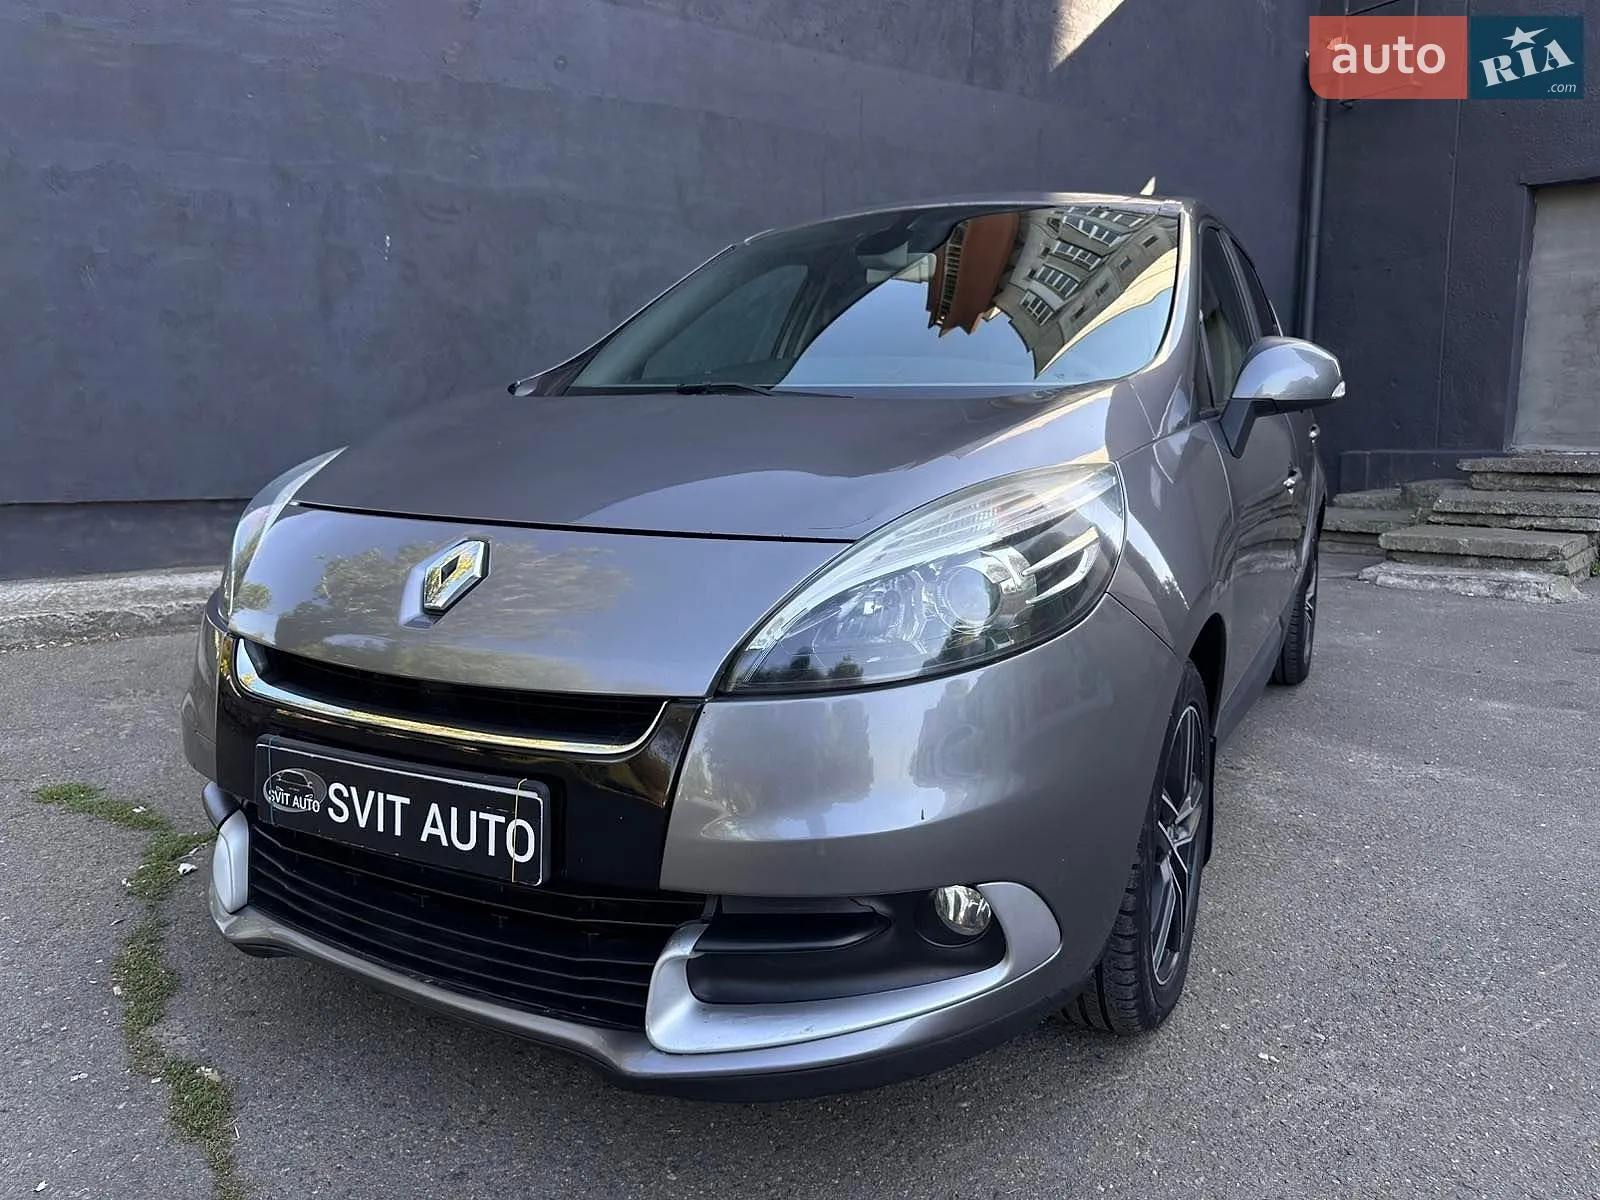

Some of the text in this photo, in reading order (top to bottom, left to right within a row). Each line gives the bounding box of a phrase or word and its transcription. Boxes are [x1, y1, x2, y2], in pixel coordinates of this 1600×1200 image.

[268, 790, 320, 812] SVIT AUTO
[327, 782, 535, 863] SVIT AUTO
